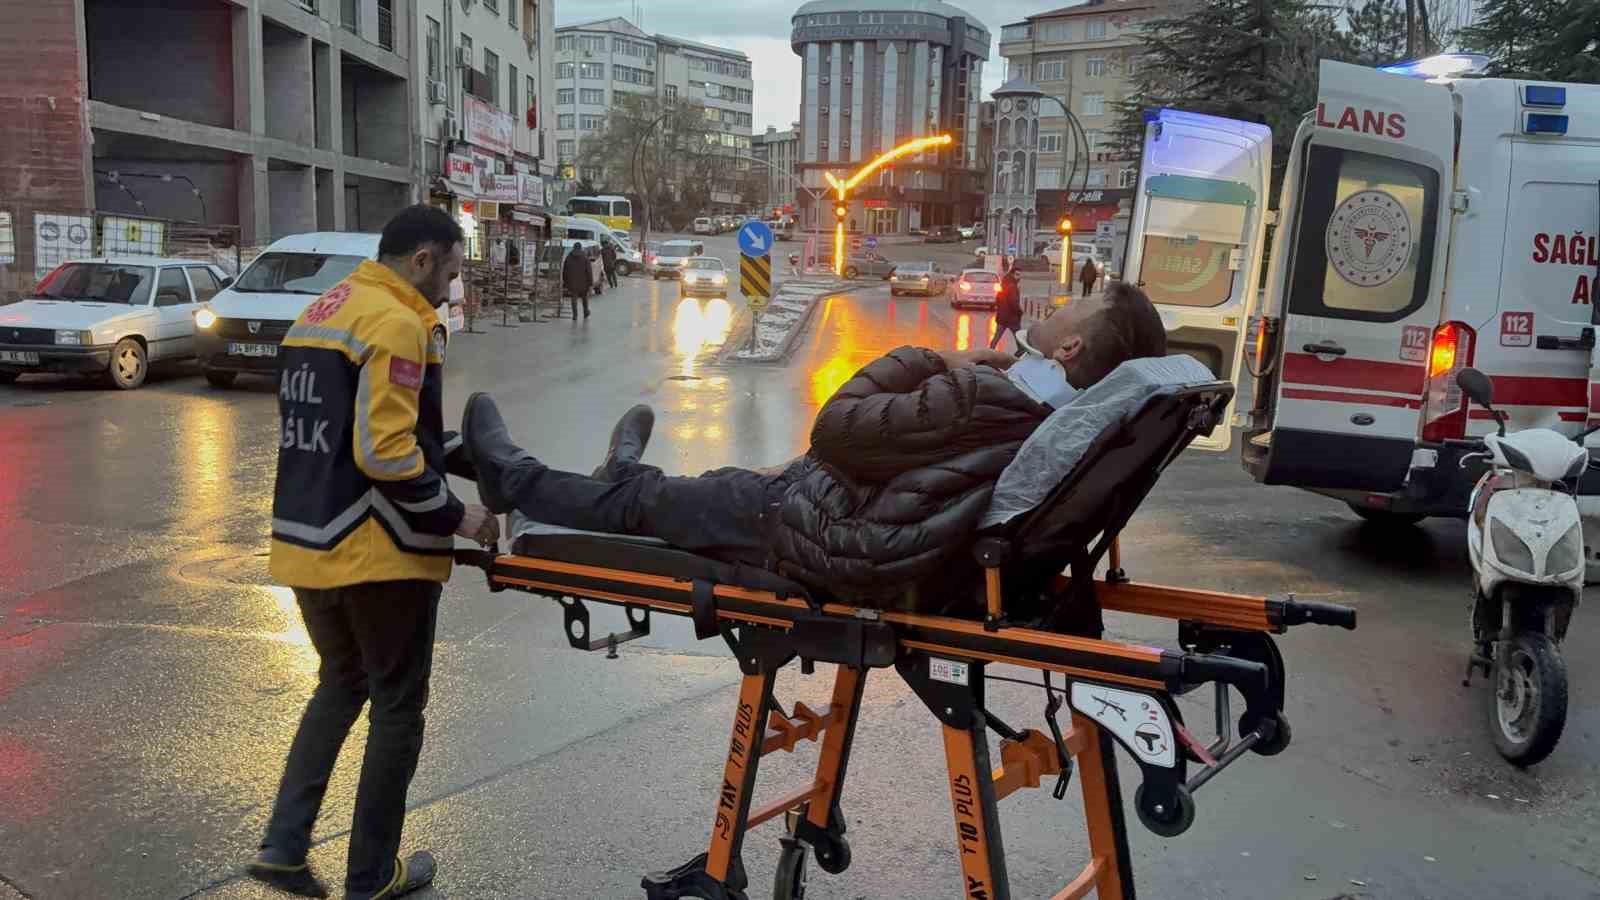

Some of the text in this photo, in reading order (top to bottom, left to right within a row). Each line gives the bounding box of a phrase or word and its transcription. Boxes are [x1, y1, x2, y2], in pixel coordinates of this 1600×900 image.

[1316, 102, 1406, 138] LANS
[1404, 329, 1426, 347] 112
[1506, 315, 1529, 333] 112
[720, 779, 737, 810] TAY
[735, 700, 753, 739] PLUS
[953, 773, 973, 817] PLUS
